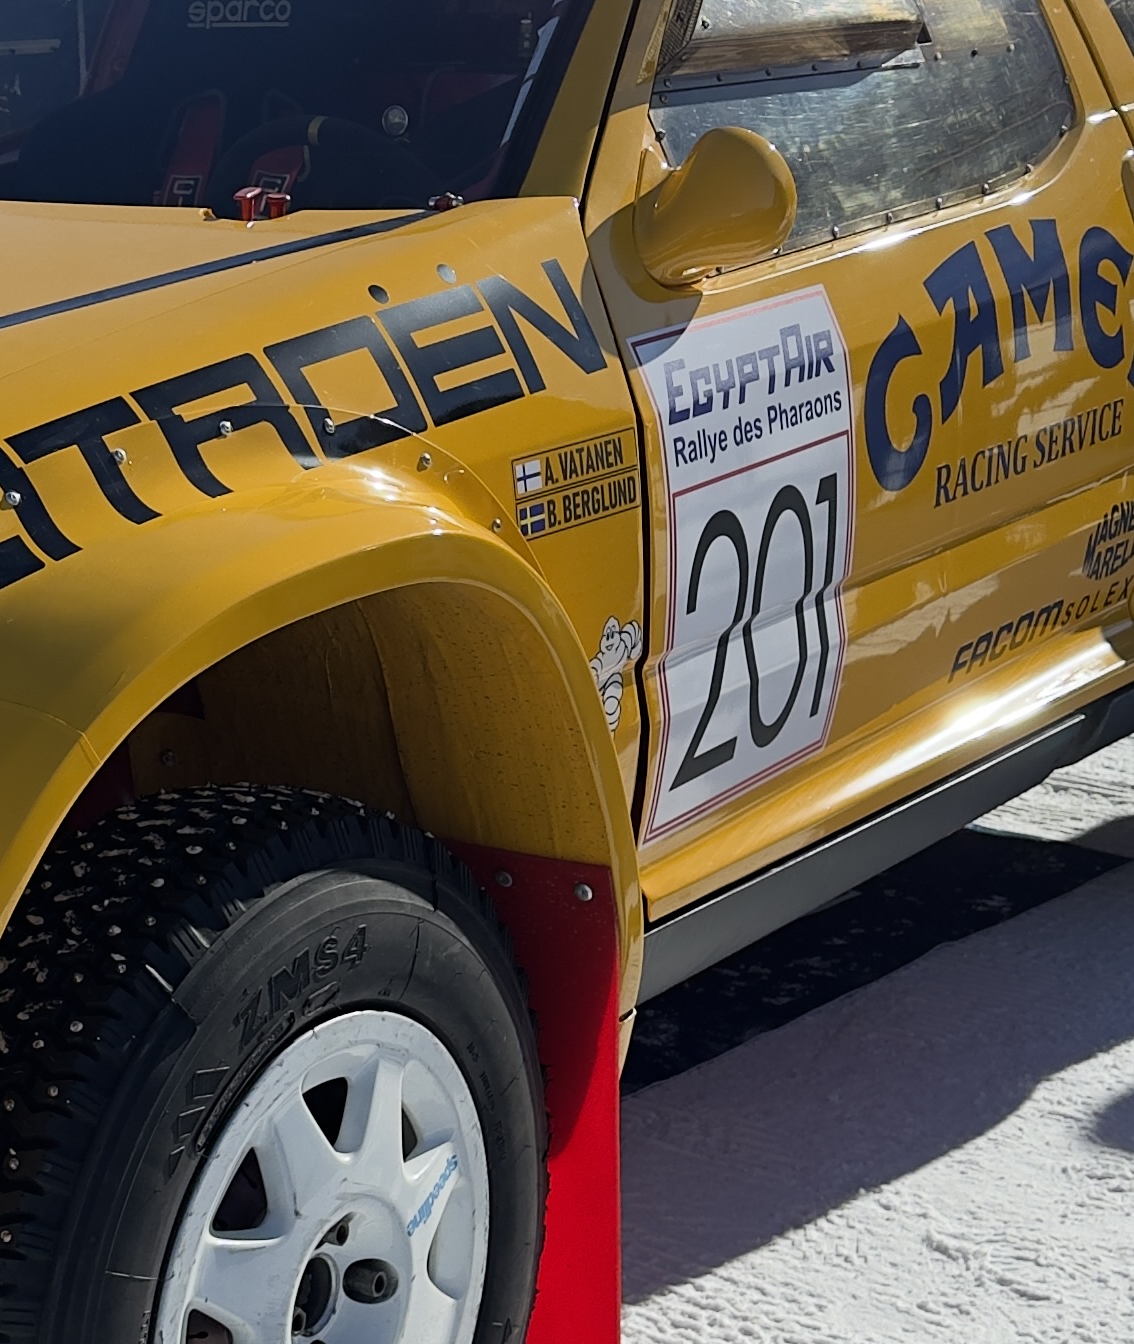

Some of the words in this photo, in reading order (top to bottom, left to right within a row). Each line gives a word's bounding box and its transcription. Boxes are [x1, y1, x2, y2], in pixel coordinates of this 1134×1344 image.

[864, 218, 1134, 492] CAME
[544, 456, 559, 487] A.
[557, 436, 624, 482] VATANEN
[672, 428, 728, 468] Rallye
[733, 416, 763, 447] des
[766, 389, 842, 435] Pharaons
[933, 432, 1028, 509] RACING
[1032, 398, 1125, 470] SERVICE
[546, 498, 562, 529] B.
[562, 475, 637, 524] BERGLUND
[668, 472, 838, 792] 201
[947, 598, 1065, 684] FACOM
[1060, 573, 1134, 627] SOLEX
[406, 1153, 460, 1238] speedline
